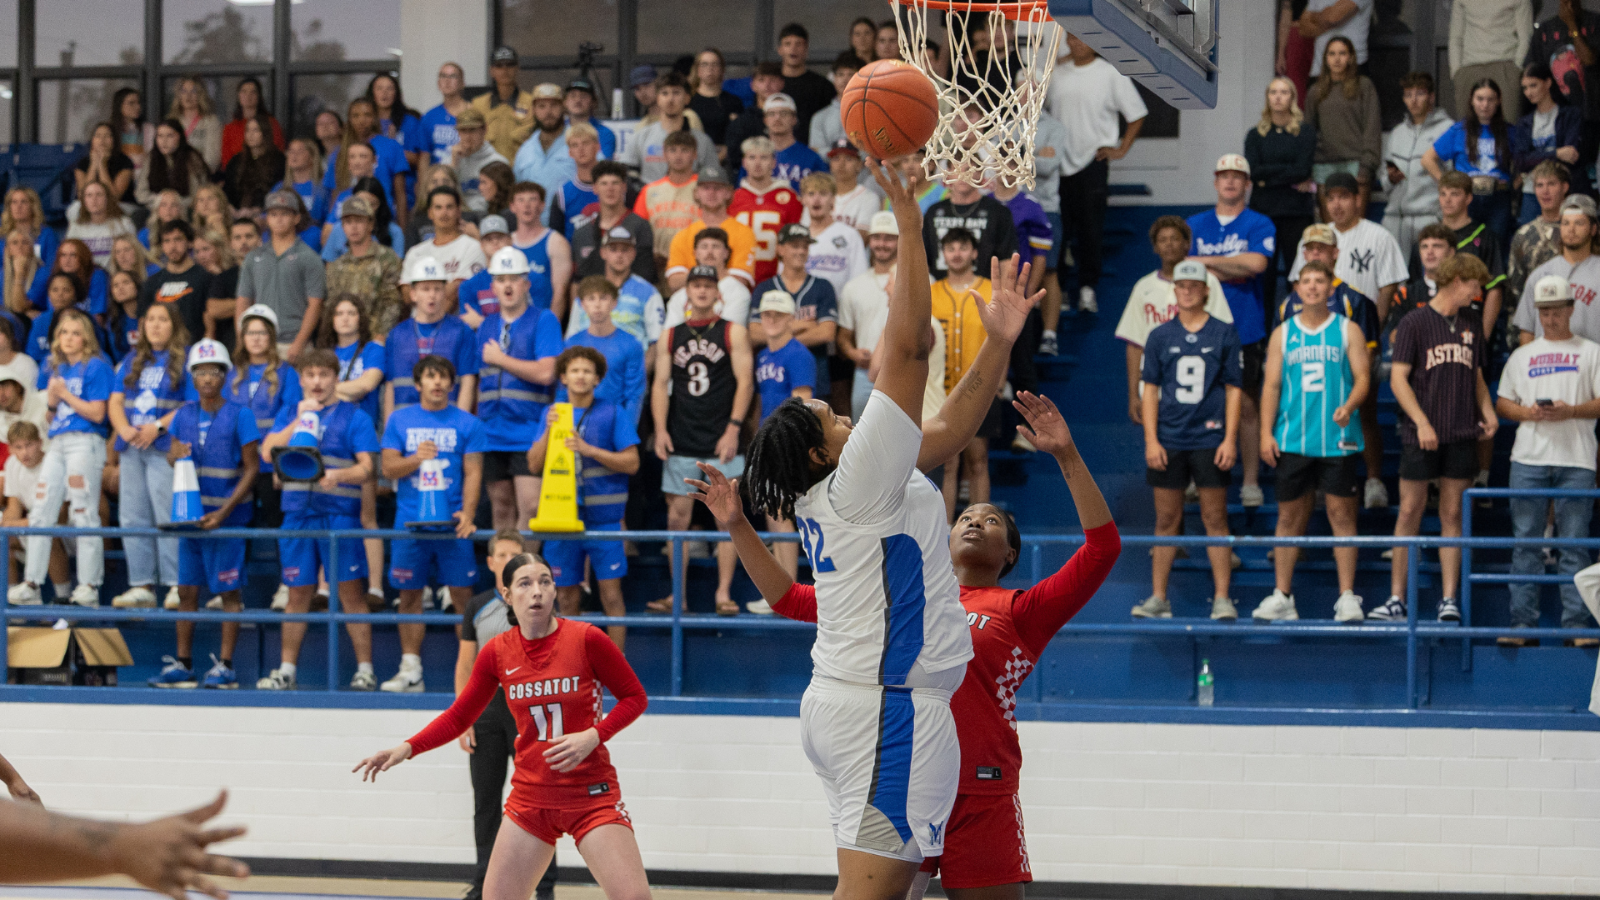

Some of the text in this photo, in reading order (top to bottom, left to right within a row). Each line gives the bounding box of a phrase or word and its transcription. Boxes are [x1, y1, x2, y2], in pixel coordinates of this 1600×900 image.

[1350, 248, 1374, 273] NY
[1287, 344, 1341, 366] HORNETS
[1528, 352, 1580, 366] MURRAY
[687, 361, 711, 396] 3
[1176, 355, 1206, 404] 9
[1301, 361, 1326, 392] 2
[509, 676, 580, 700] COSSATOT
[528, 702, 564, 742] 11
